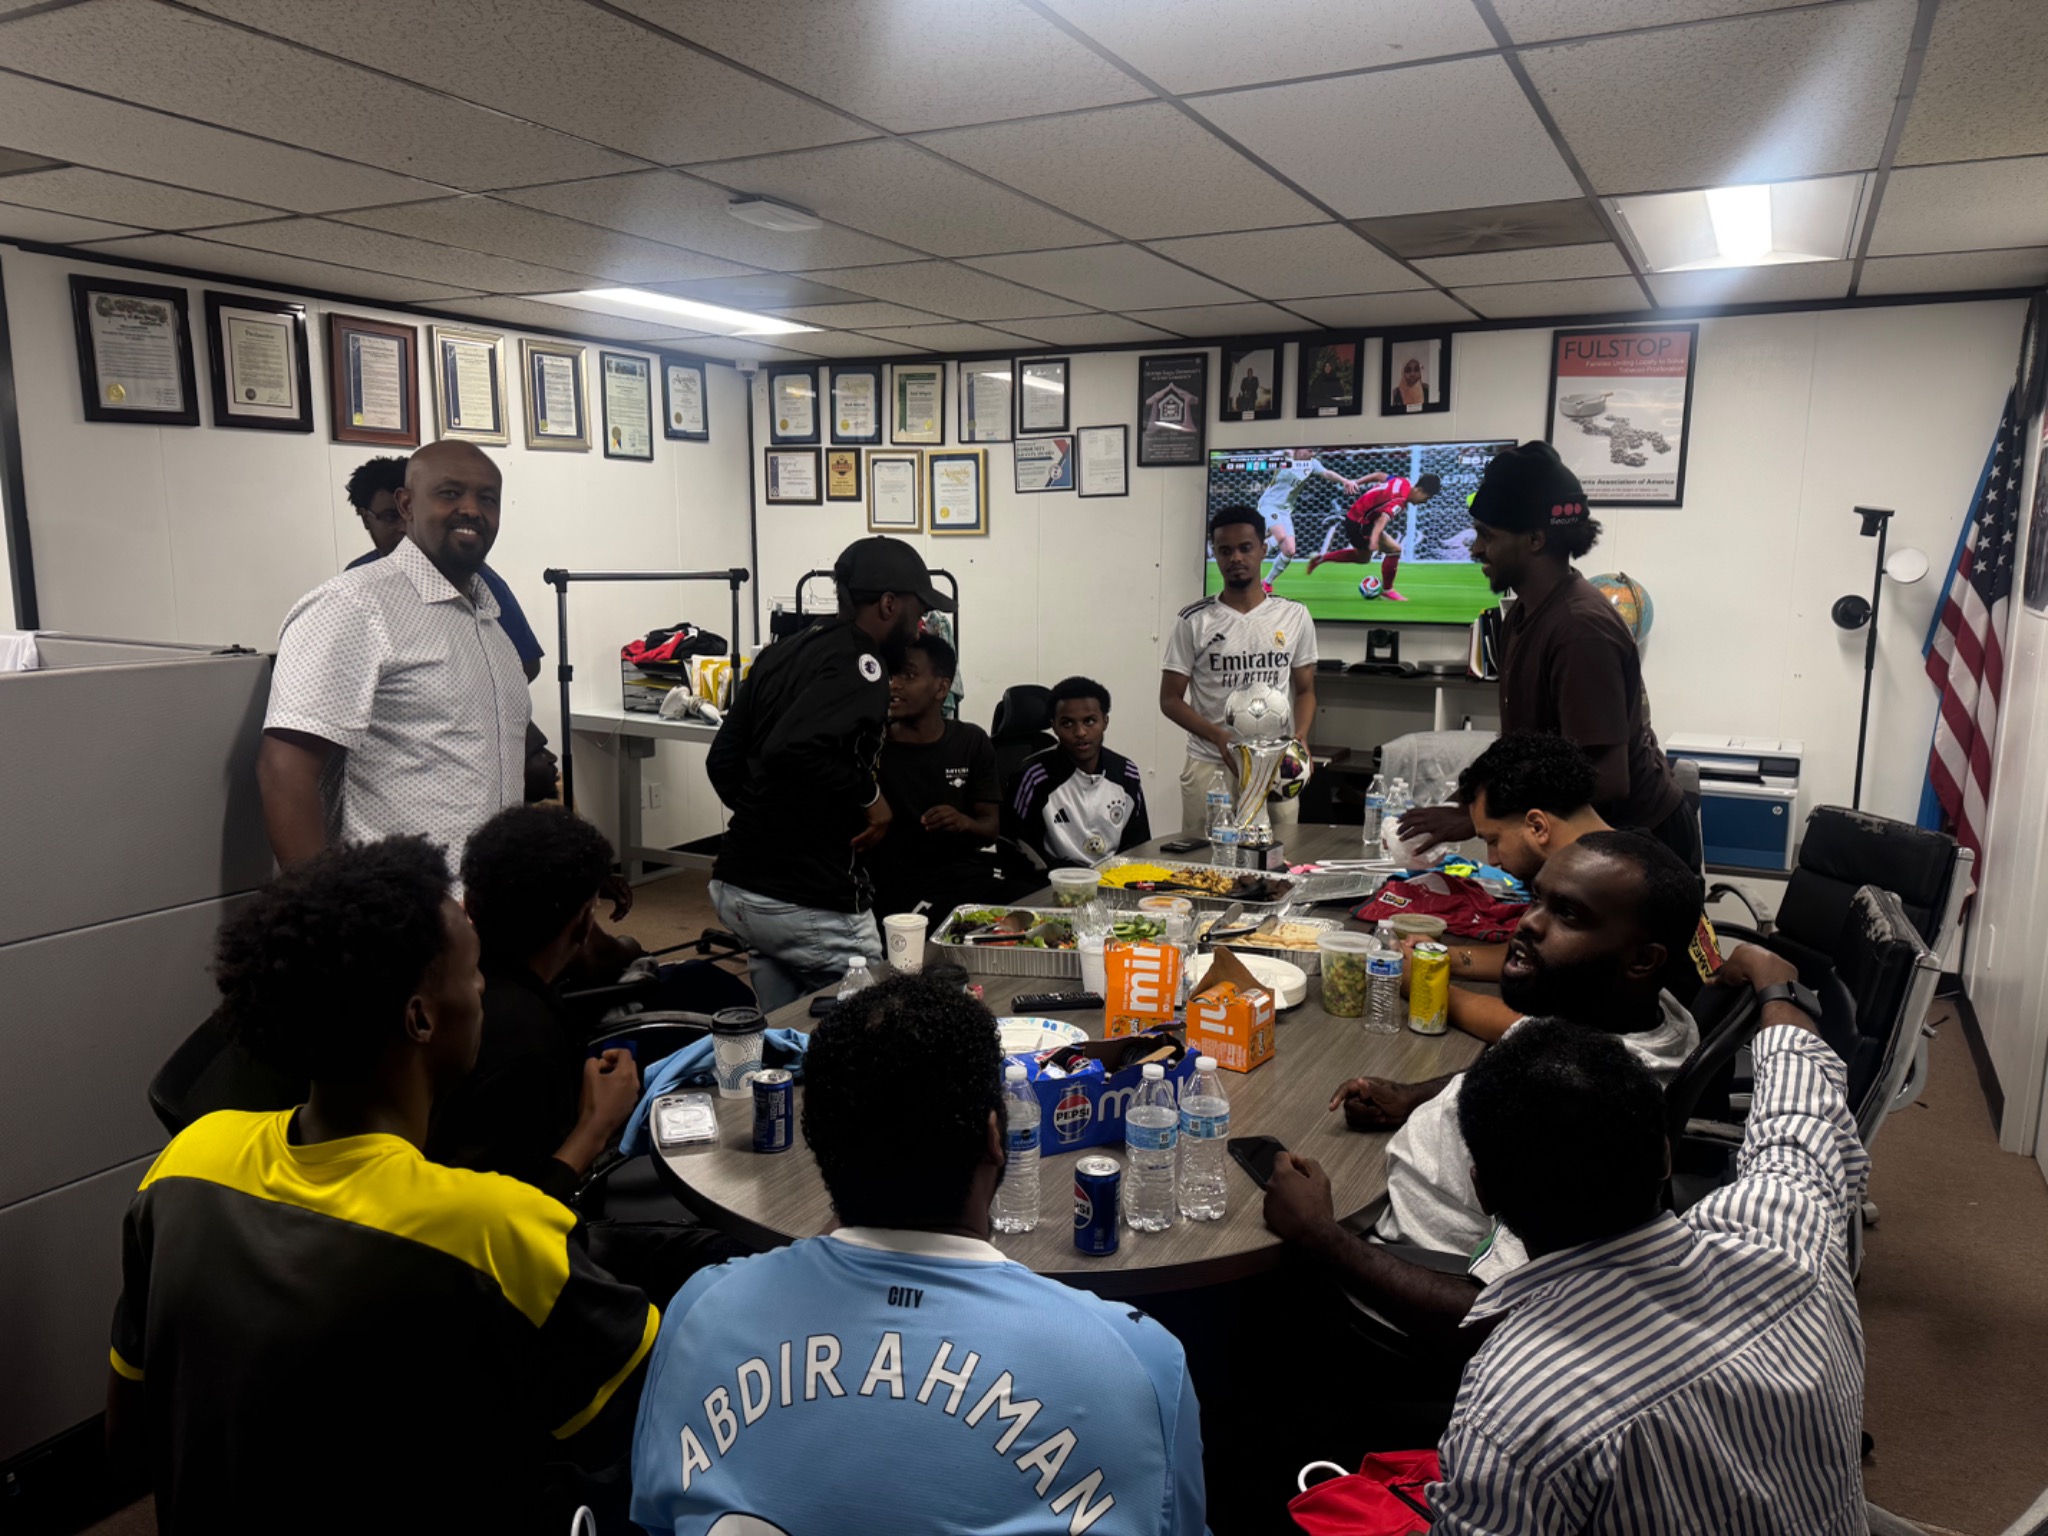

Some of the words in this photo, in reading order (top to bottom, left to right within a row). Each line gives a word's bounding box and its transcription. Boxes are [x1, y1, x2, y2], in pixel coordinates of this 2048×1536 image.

[1564, 337, 1672, 360] FULSTOP
[1597, 478, 1636, 486] Association
[1637, 478, 1645, 486] of
[1646, 477, 1675, 486] America
[1209, 650, 1290, 671] Emirates
[1222, 673, 1240, 688] FLY
[1056, 1108, 1090, 1121] PEPSI
[887, 1285, 924, 1309] CITY
[678, 1331, 1116, 1536] ABDIRAHMAN
